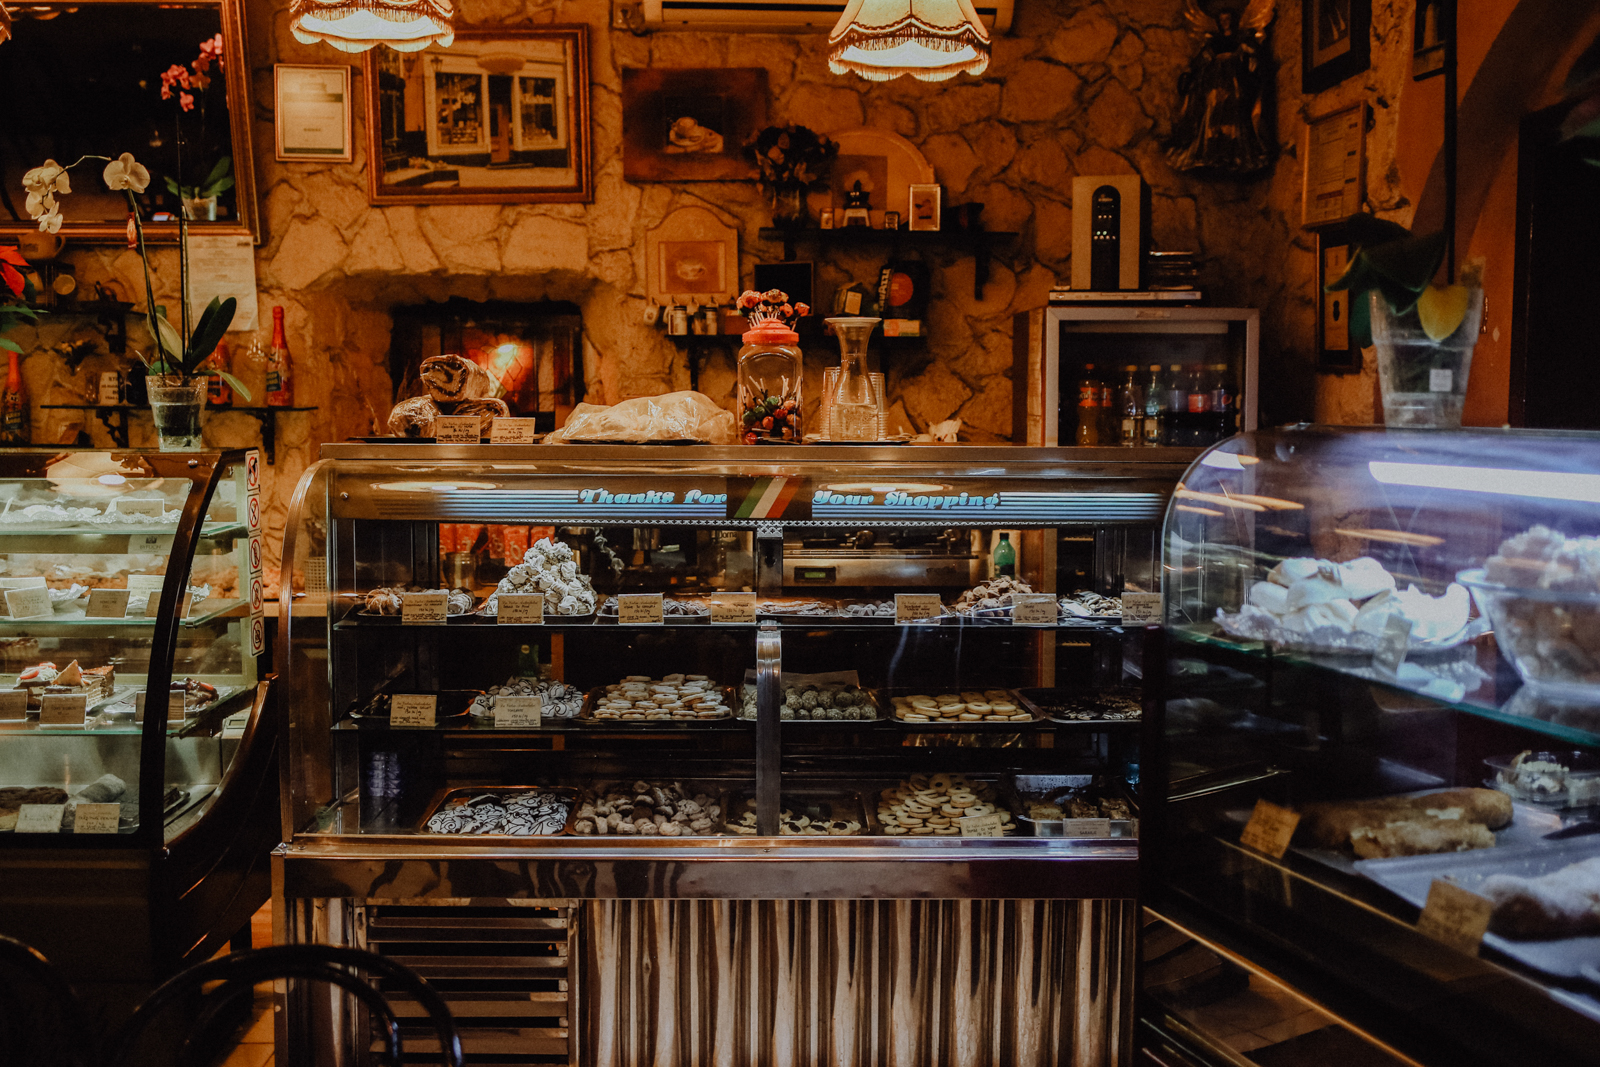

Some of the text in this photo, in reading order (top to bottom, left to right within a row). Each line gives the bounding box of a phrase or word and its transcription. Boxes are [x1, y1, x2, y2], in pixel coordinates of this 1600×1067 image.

[579, 488, 999, 510] Thanks for Your Shopping
